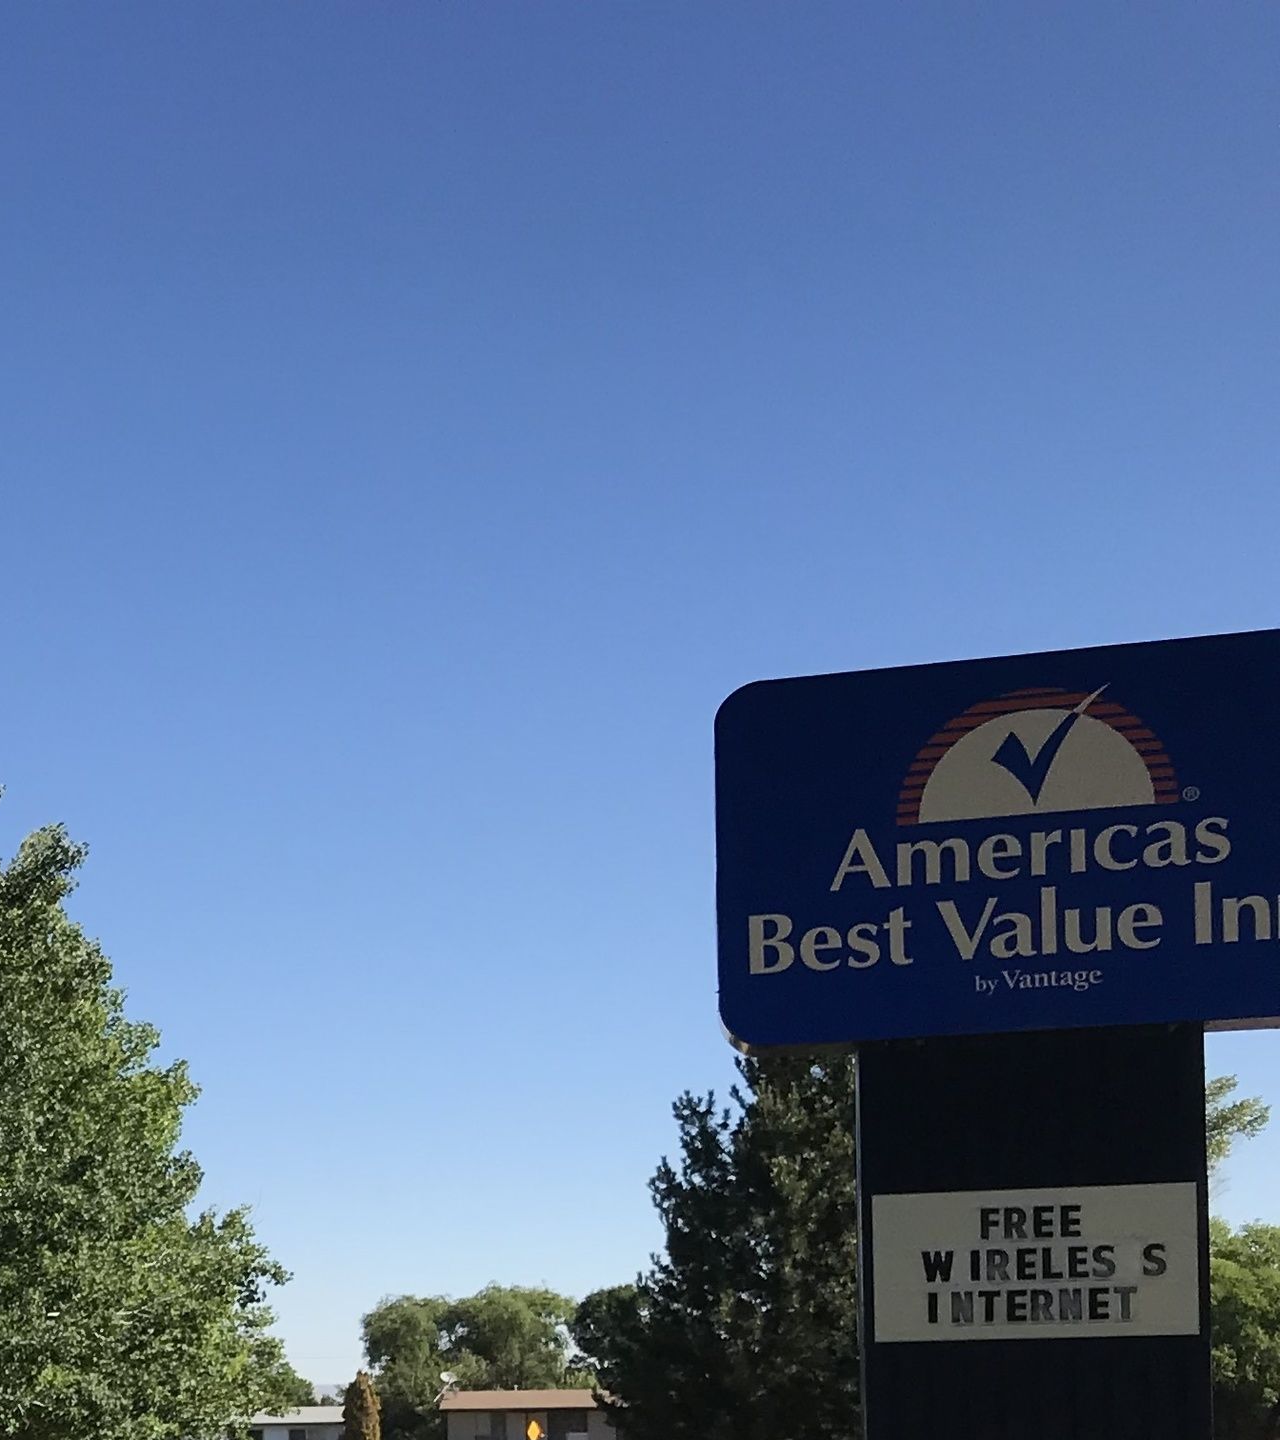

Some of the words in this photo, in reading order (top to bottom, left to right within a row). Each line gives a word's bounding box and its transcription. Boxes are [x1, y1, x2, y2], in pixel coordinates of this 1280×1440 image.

[830, 816, 1231, 892] Americas
[748, 906, 914, 975] Best
[936, 886, 1163, 961] Value
[1194, 881, 1280, 945] In
[974, 975, 999, 996] by
[1001, 969, 1103, 992] Vantage
[980, 1204, 1082, 1241] FREE
[927, 1286, 1138, 1324] INTERNET
